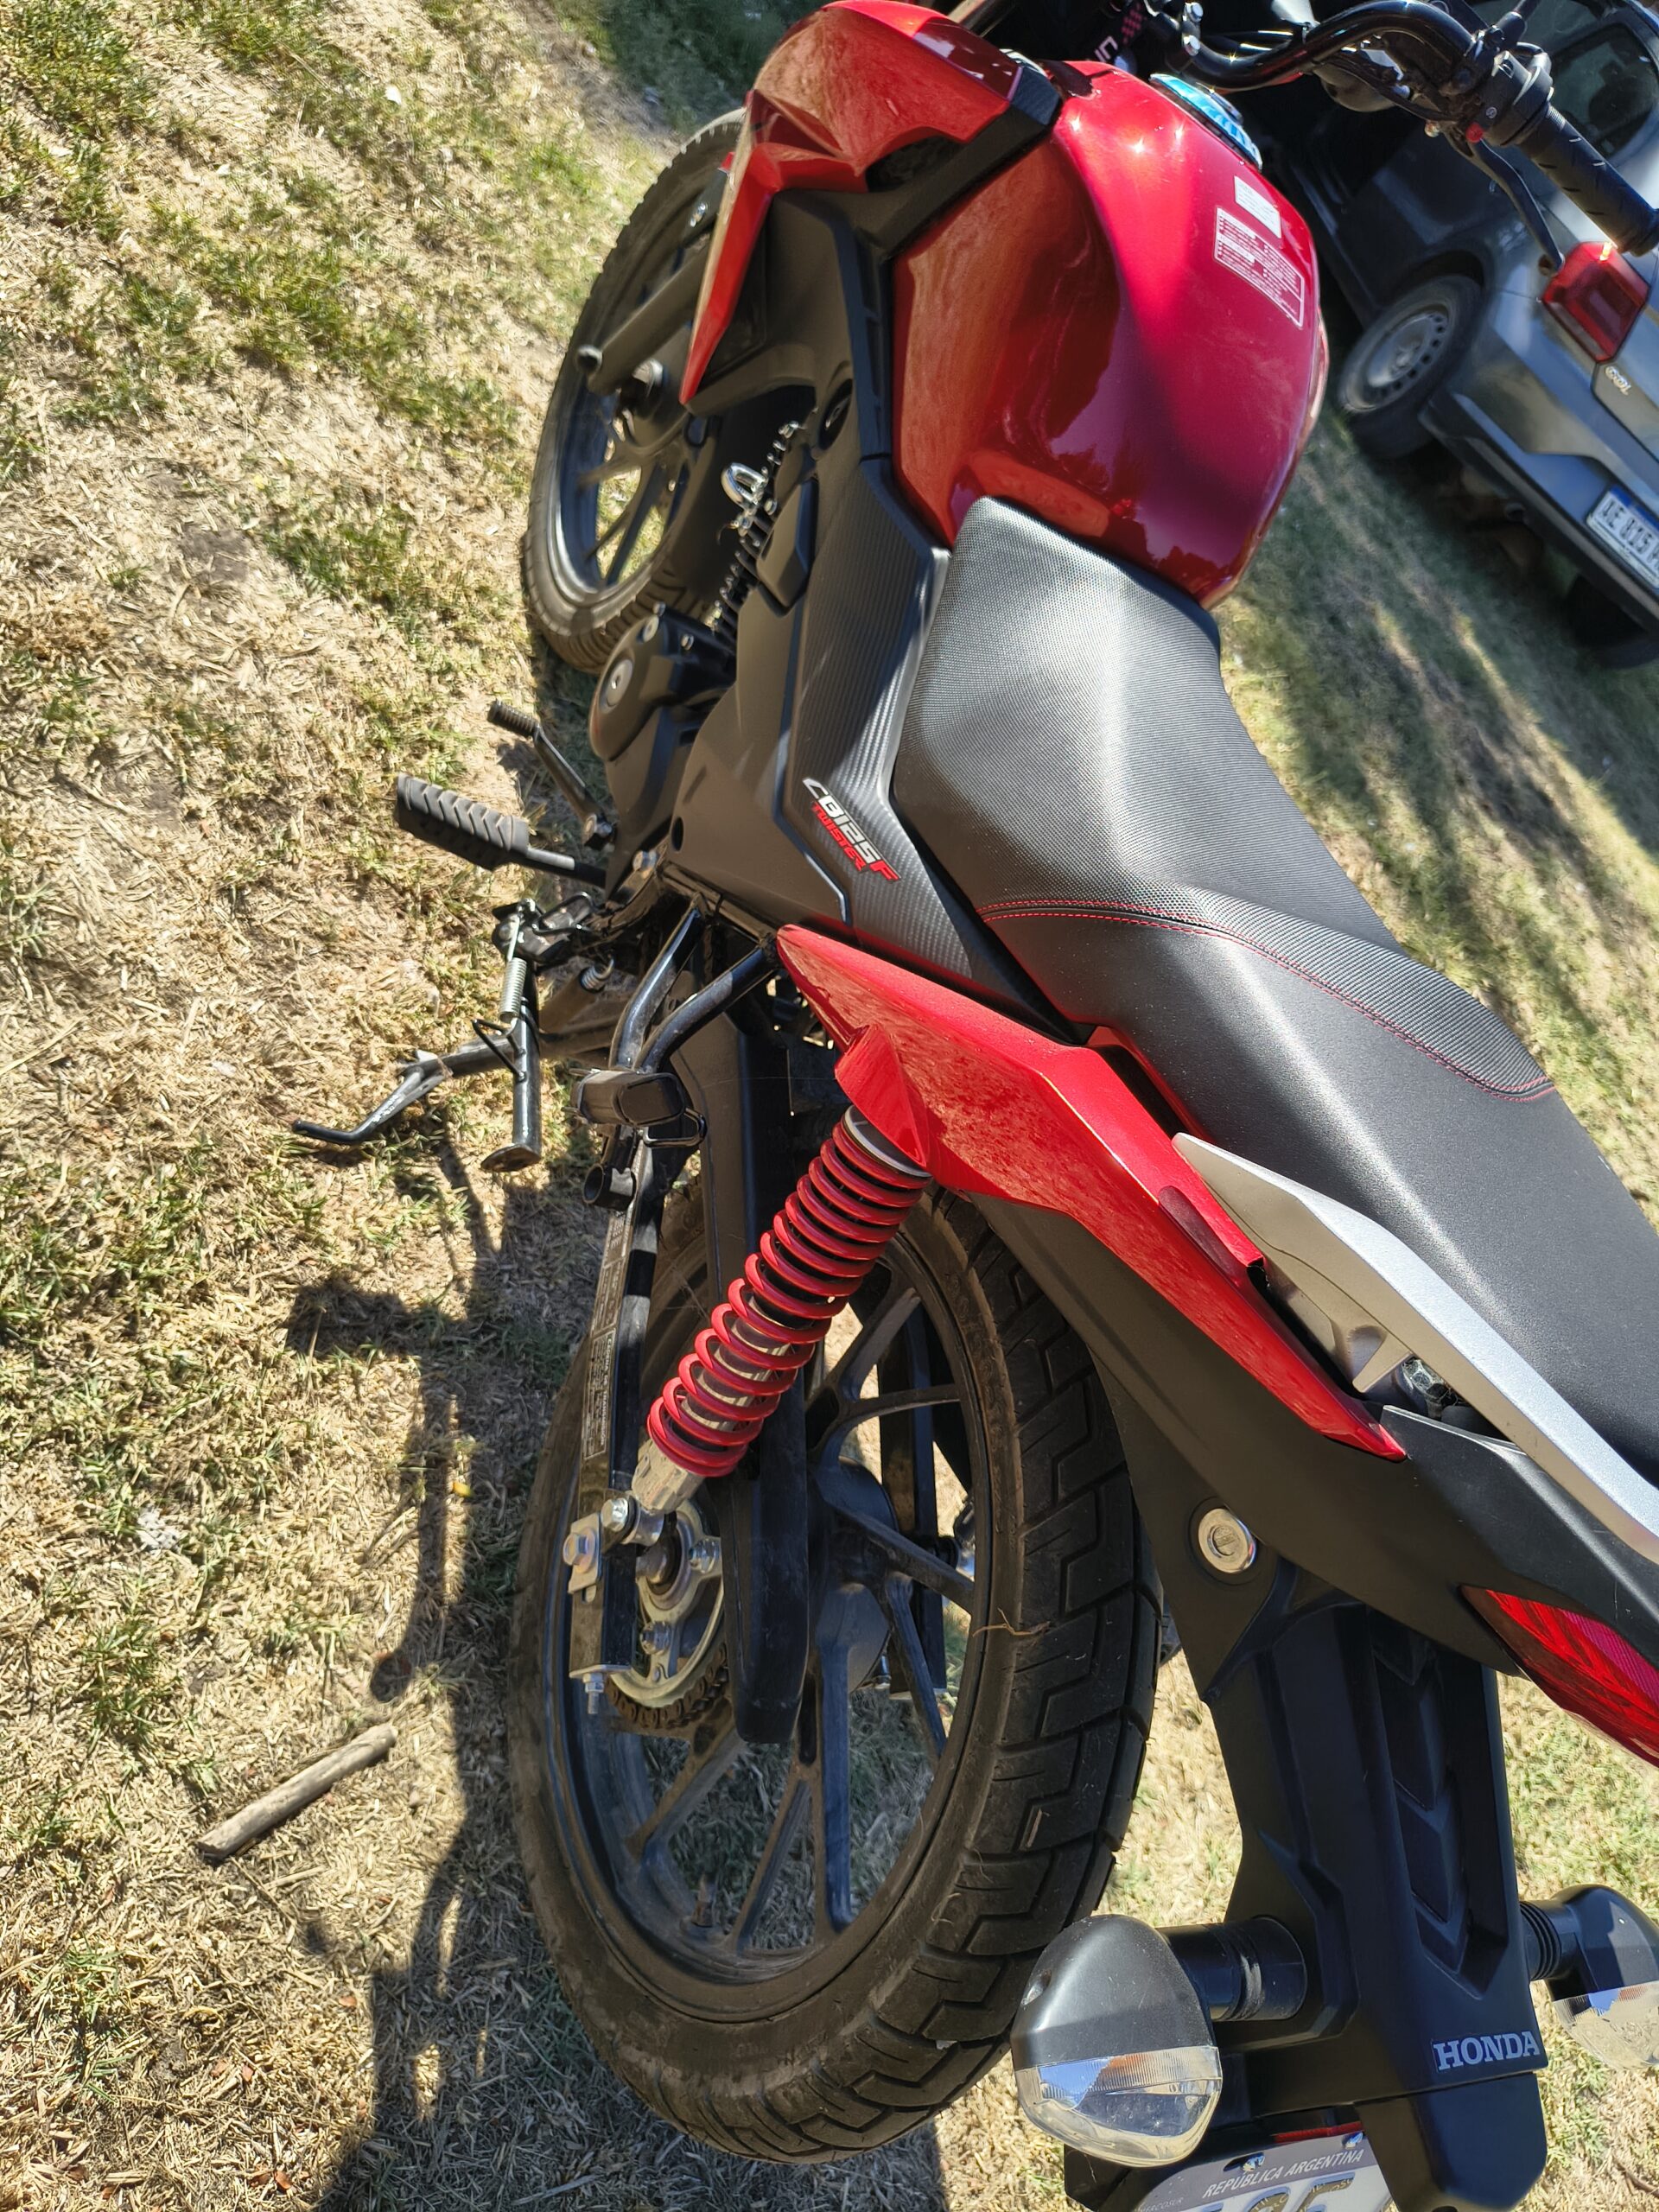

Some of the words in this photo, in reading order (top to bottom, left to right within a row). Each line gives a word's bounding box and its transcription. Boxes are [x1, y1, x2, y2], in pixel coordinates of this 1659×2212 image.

[812, 801, 867, 871] TWISTER
[1433, 2031, 1540, 2070] HONDA
[1284, 2149, 1364, 2177] ARGENTINA
